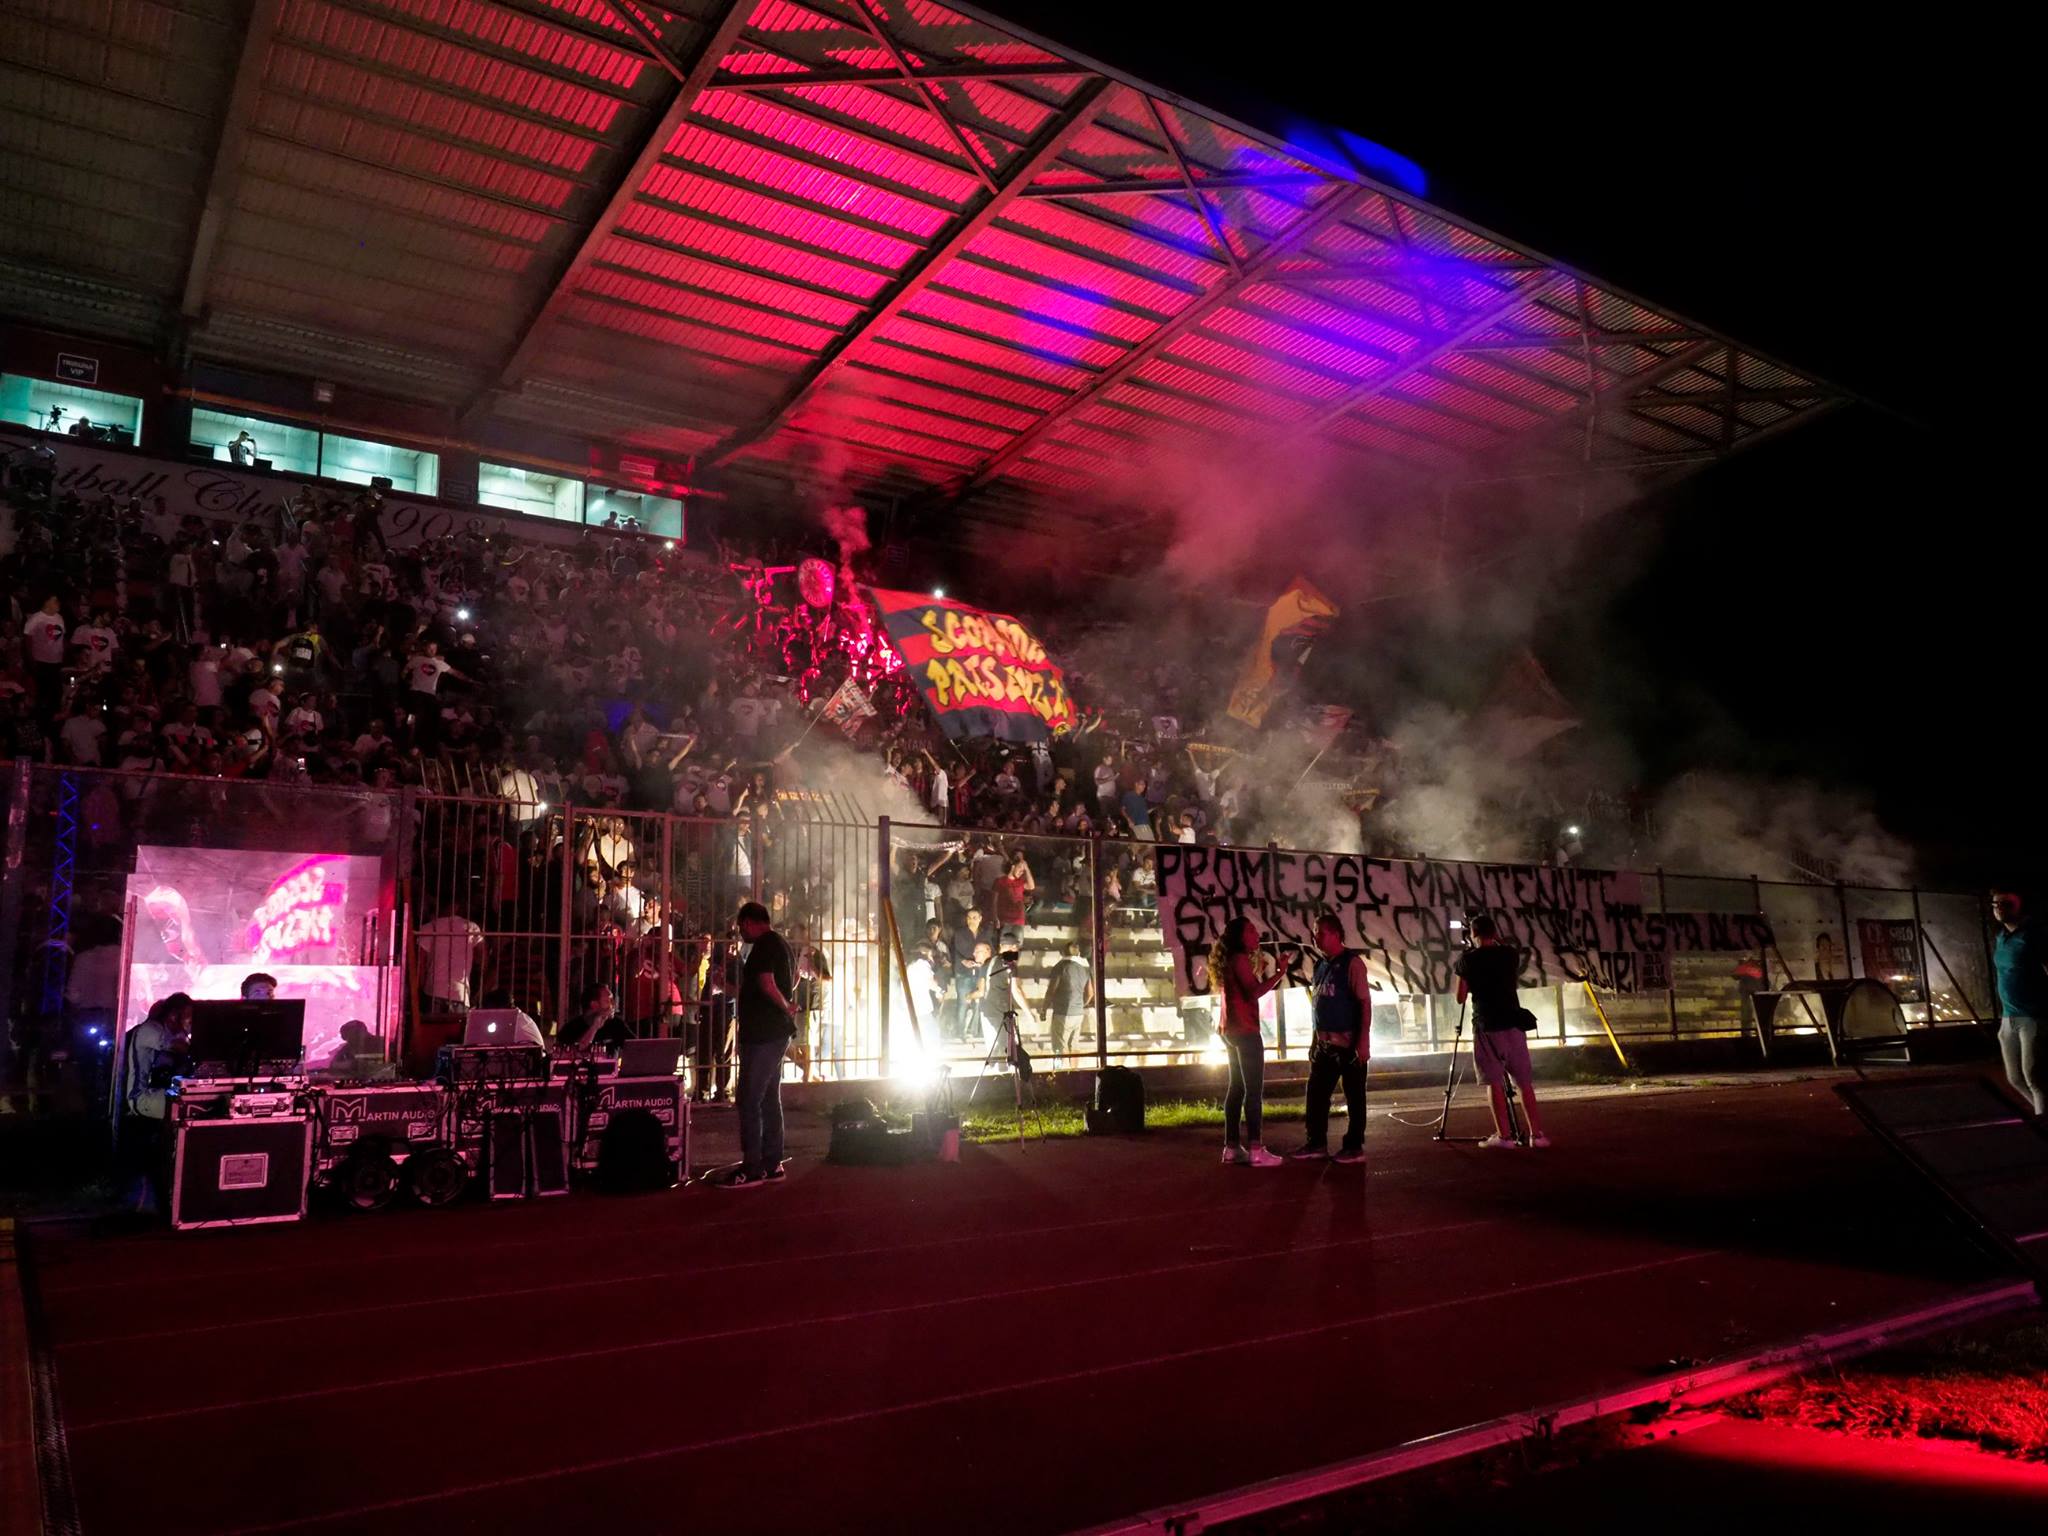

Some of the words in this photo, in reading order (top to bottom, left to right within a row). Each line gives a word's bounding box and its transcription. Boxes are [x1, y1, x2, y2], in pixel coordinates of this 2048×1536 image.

[184, 469, 276, 516] Clu
[1155, 845, 1391, 905] PROMESSE
[1405, 860, 1617, 908] MANTENUTE
[1605, 902, 1704, 953] TESTA
[644, 1096, 673, 1108] AUDIO
